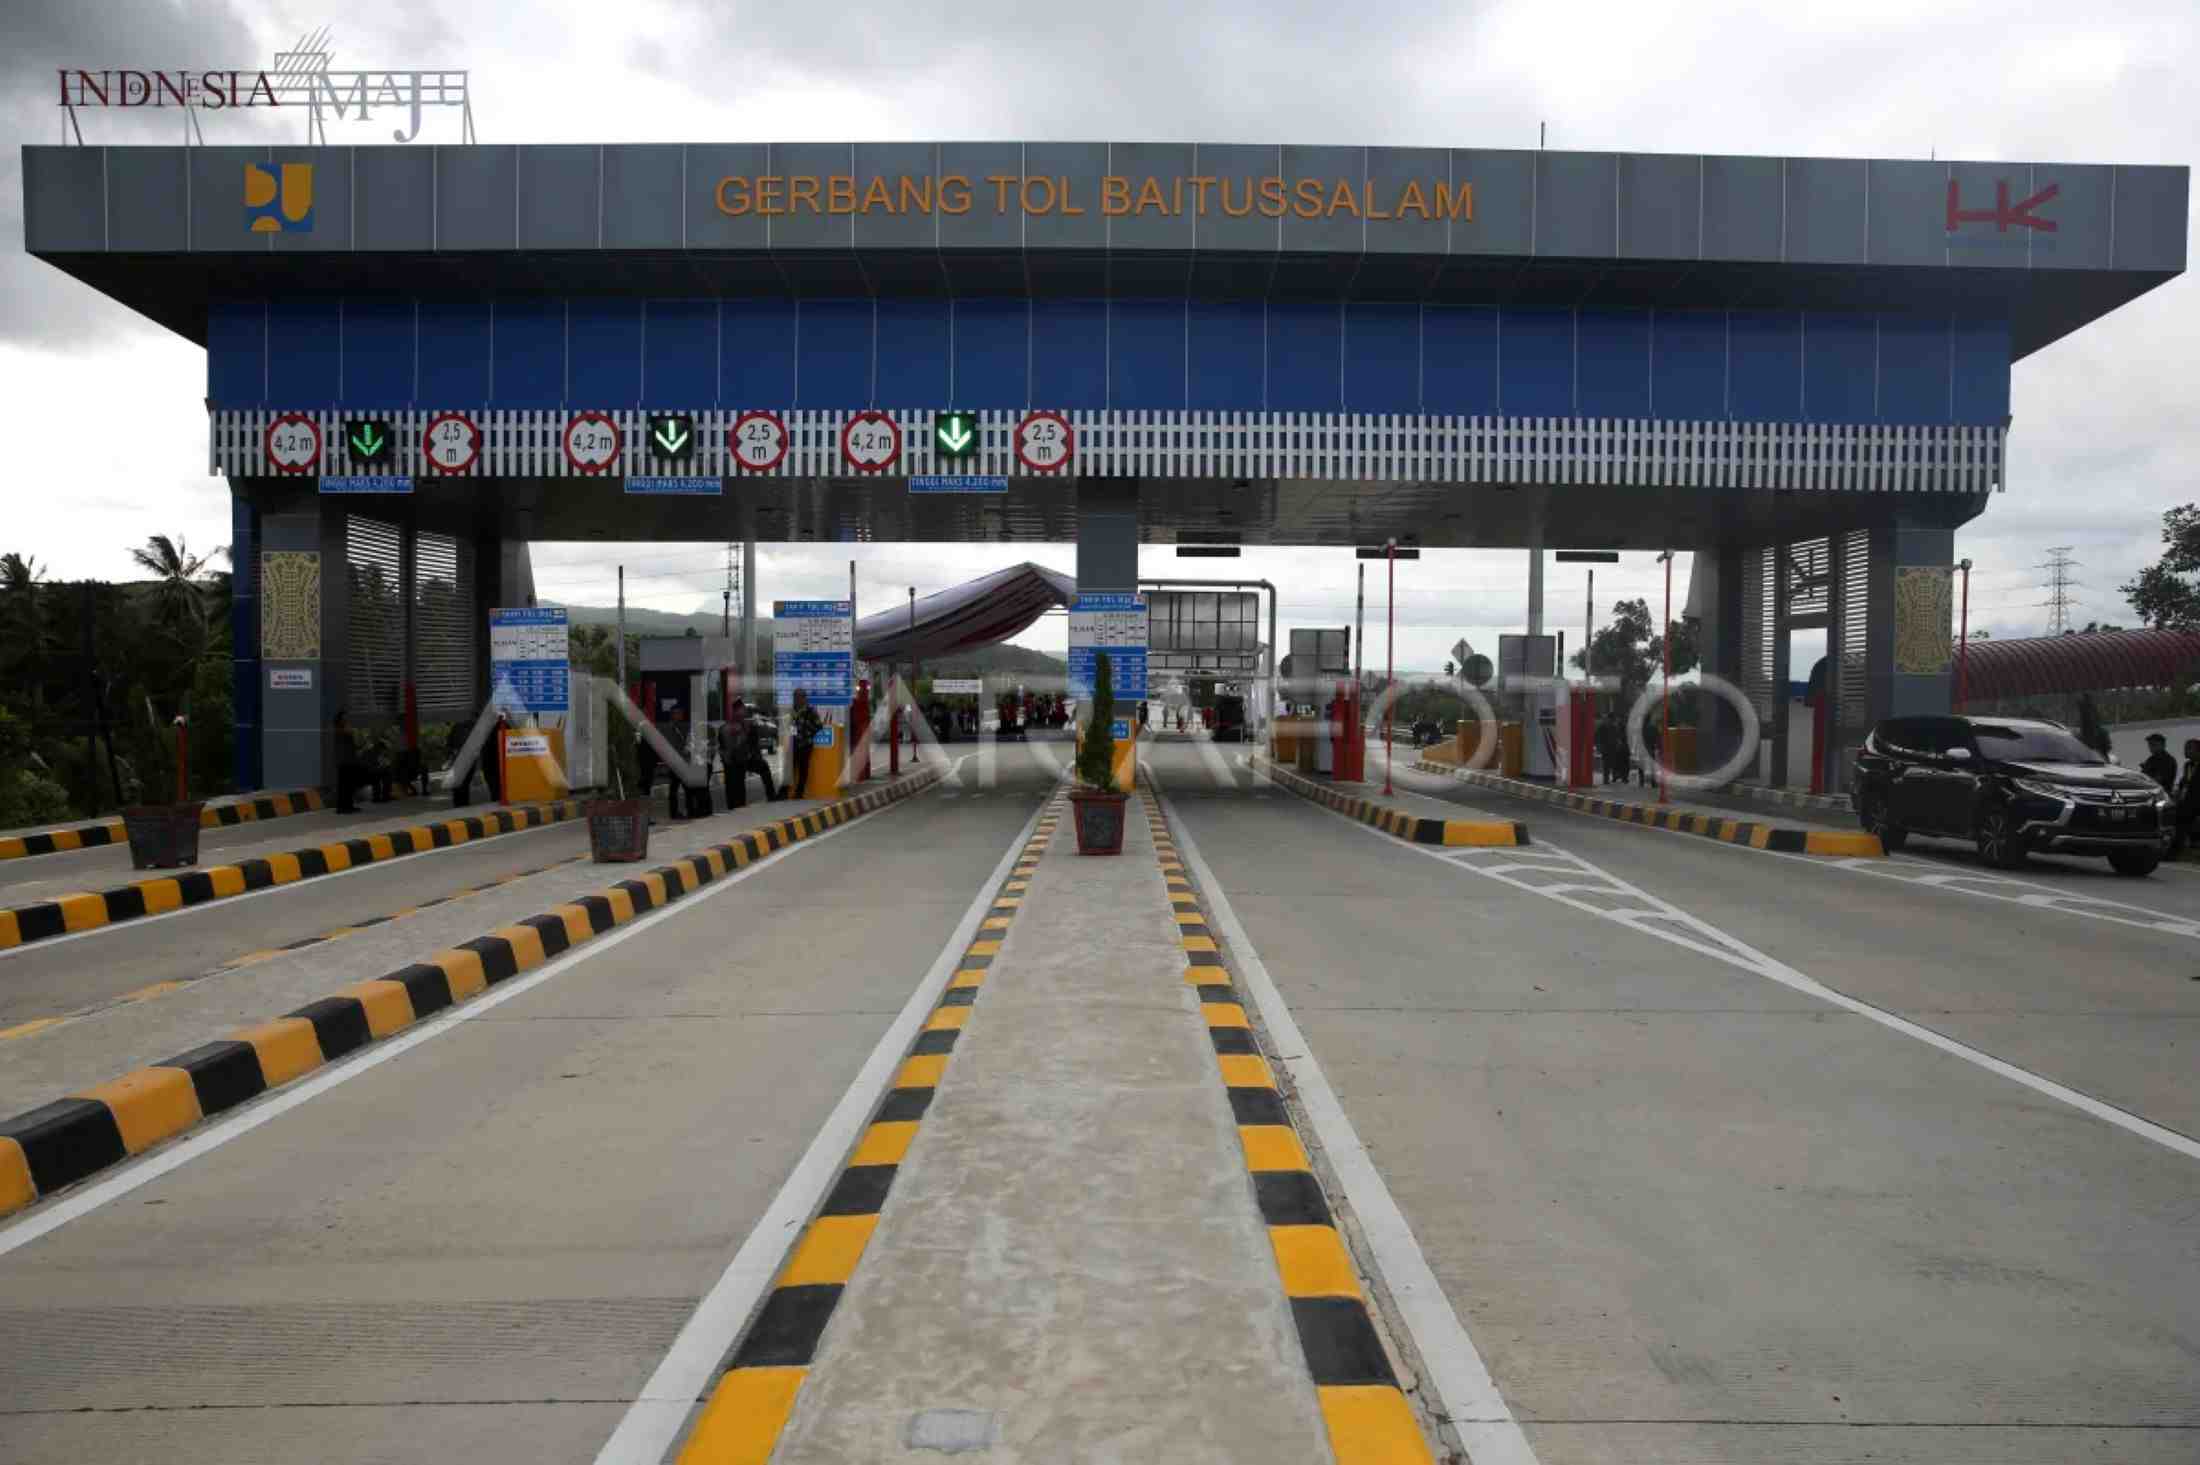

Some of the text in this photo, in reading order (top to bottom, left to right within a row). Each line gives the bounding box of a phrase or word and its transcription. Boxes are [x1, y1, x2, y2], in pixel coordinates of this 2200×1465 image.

[714, 175, 1475, 221] GERBANG TOL BAITUSSALAM
[1945, 181, 2057, 232] HK
[443, 423, 461, 442] 2,5
[747, 425, 771, 442] 2,5
[1033, 425, 1056, 442] 2,5
[274, 435, 313, 453] 4,2 m
[573, 433, 613, 451] 4,2 m
[851, 433, 892, 451] 4,2 m
[446, 447, 457, 458] m
[752, 446, 767, 459] m
[1038, 446, 1052, 460] m
